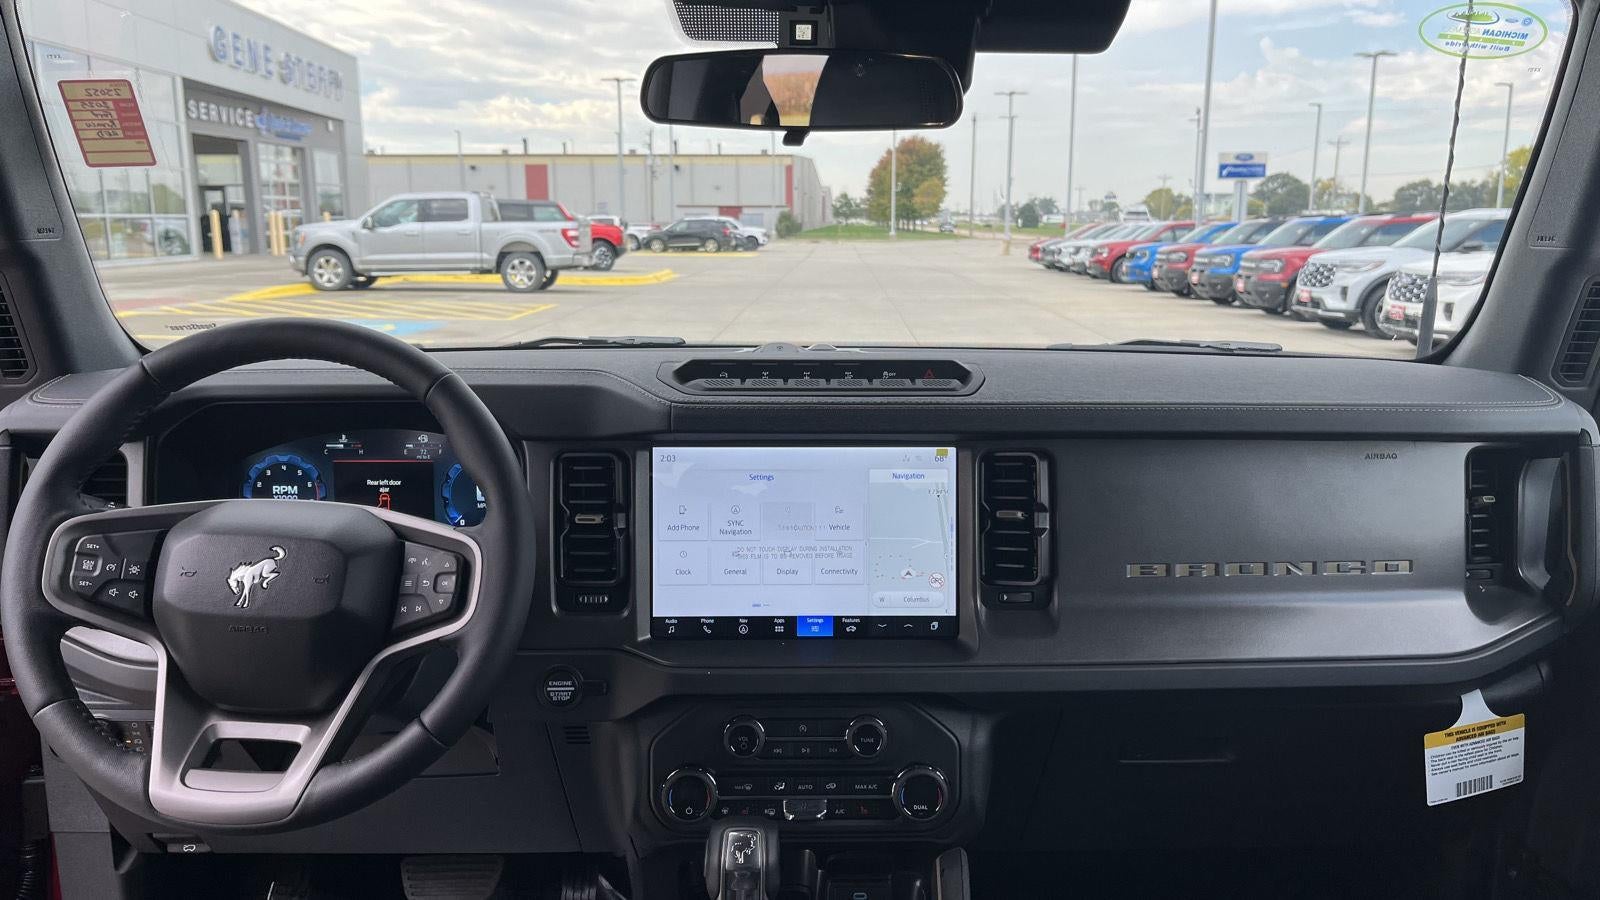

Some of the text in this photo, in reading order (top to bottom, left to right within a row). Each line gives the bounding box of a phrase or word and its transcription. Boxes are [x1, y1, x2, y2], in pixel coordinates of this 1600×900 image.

[210, 25, 274, 79] GENE
[187, 100, 255, 128] SERVICE
[660, 454, 676, 462] 2:03
[748, 474, 775, 482] Settings
[892, 472, 925, 481] Navigation
[272, 485, 298, 495] RPM
[776, 568, 799, 576] Display
[820, 568, 859, 576] Connectivity
[1126, 559, 1414, 578] BRONCO
